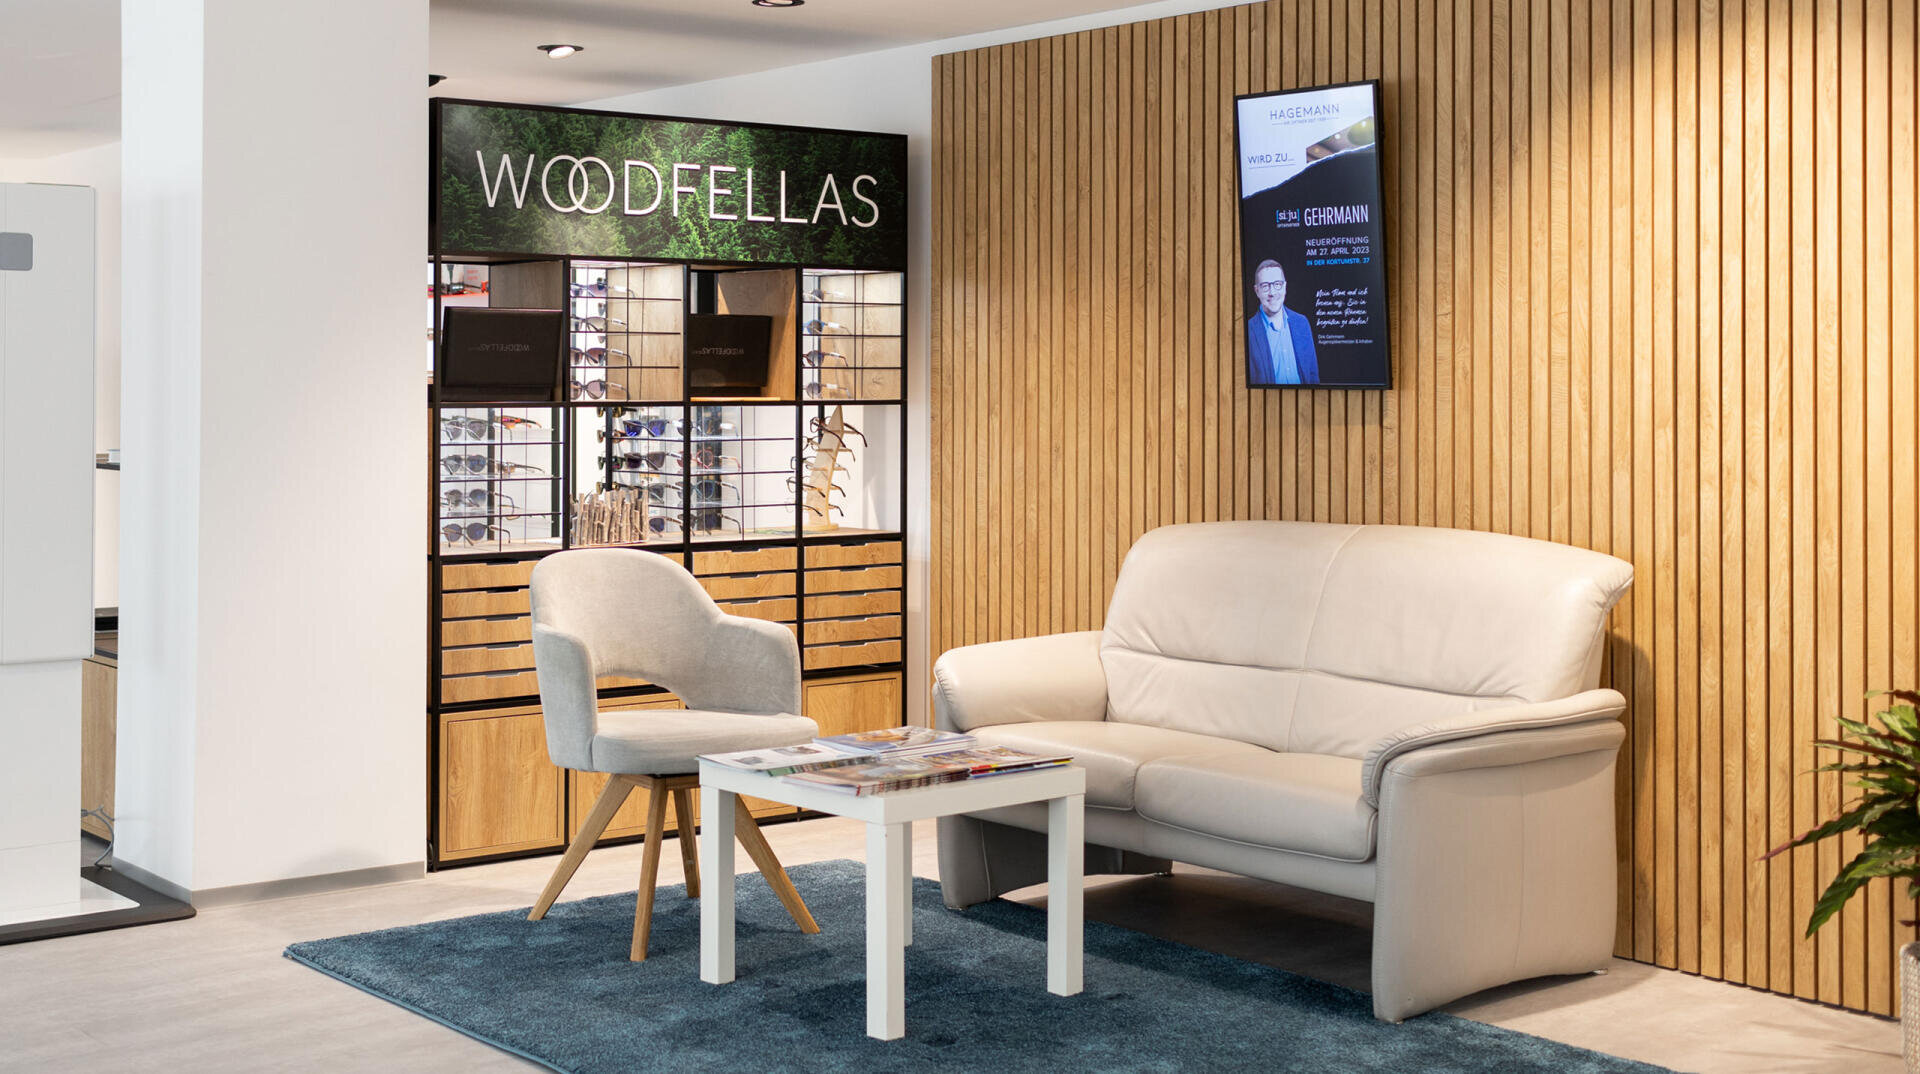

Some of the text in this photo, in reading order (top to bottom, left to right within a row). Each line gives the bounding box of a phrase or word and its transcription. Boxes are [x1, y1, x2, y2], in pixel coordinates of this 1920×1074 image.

[1270, 104, 1340, 120] HAGEMANN
[1247, 154, 1272, 165] WIRD
[475, 148, 881, 228] WOODFELLAS
[1304, 204, 1369, 226] GEHRMANN
[1305, 236, 1369, 247] NEUERÖFFNUNG
[1330, 247, 1349, 255] APRIL
[1352, 246, 1370, 254] 2023
